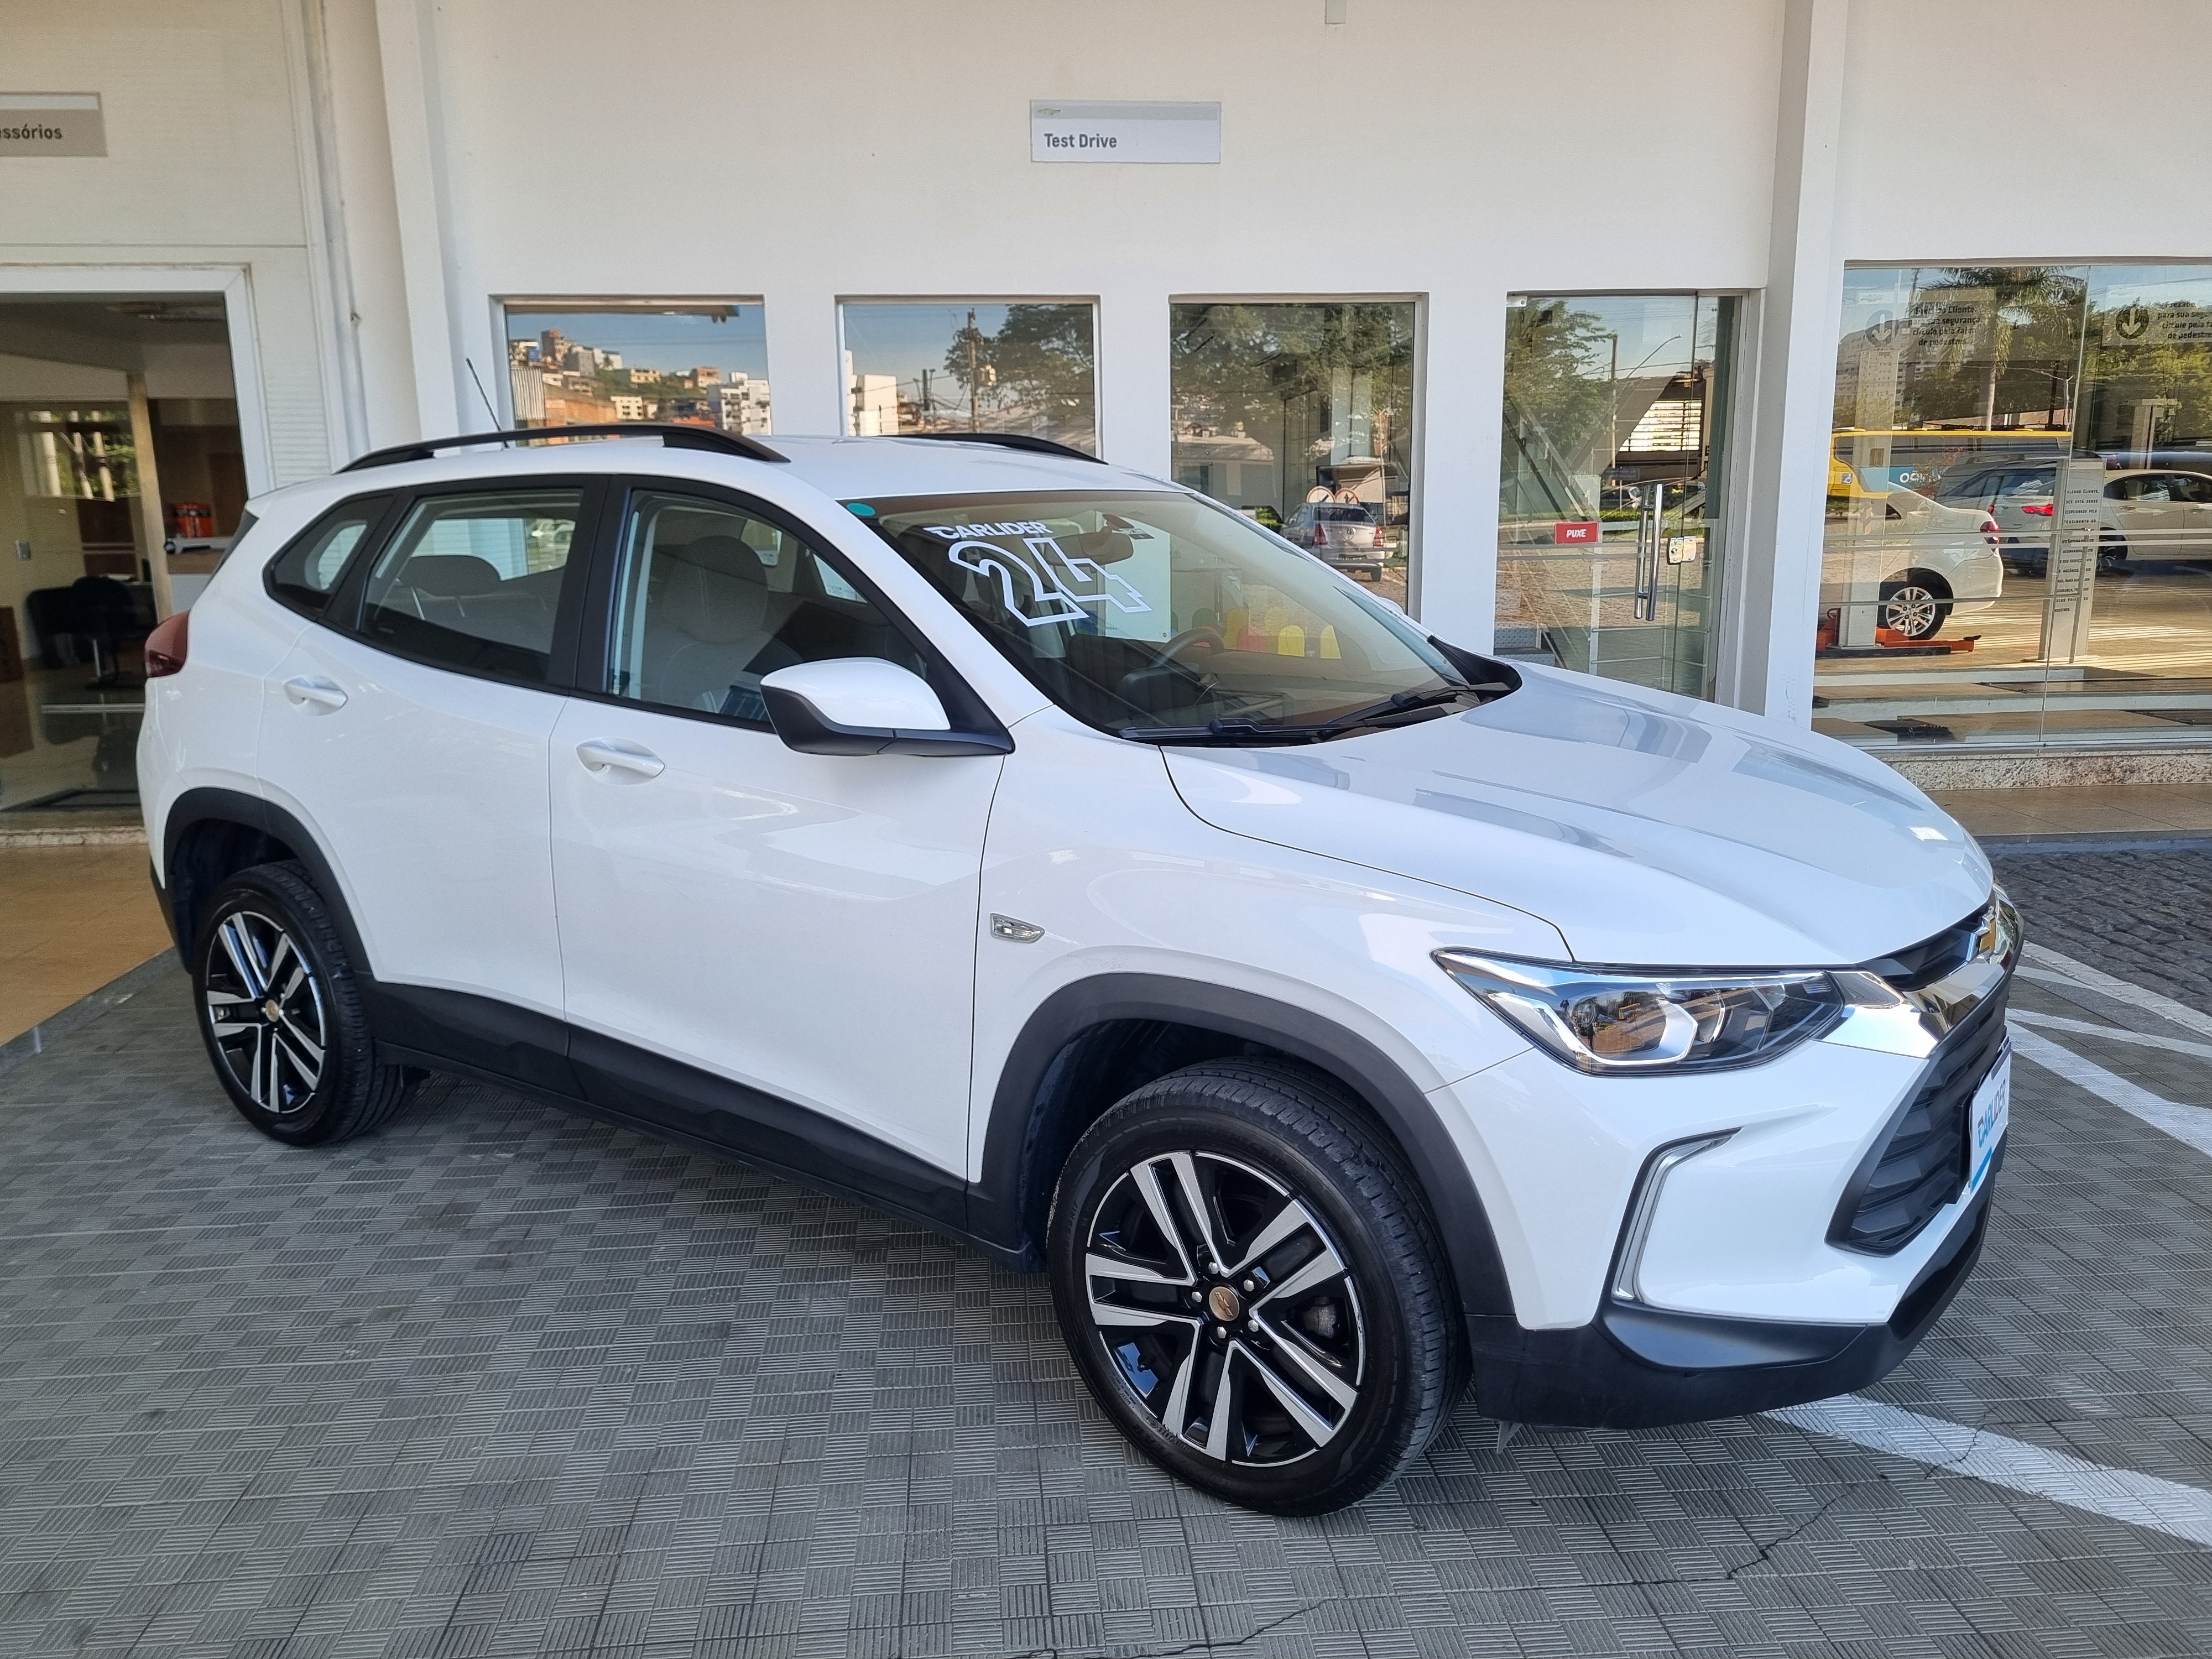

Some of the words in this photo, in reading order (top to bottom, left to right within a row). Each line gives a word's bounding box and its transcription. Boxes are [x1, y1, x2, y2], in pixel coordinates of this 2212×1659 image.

[0, 123, 62, 139] ssórios
[1044, 133, 1076, 148] Test
[1079, 133, 1117, 148] Drive
[1942, 317, 1980, 326] segurança
[2157, 311, 2174, 320] para
[1566, 529, 1587, 539] PUXE
[1976, 1078, 2006, 1149] CARLIDER
